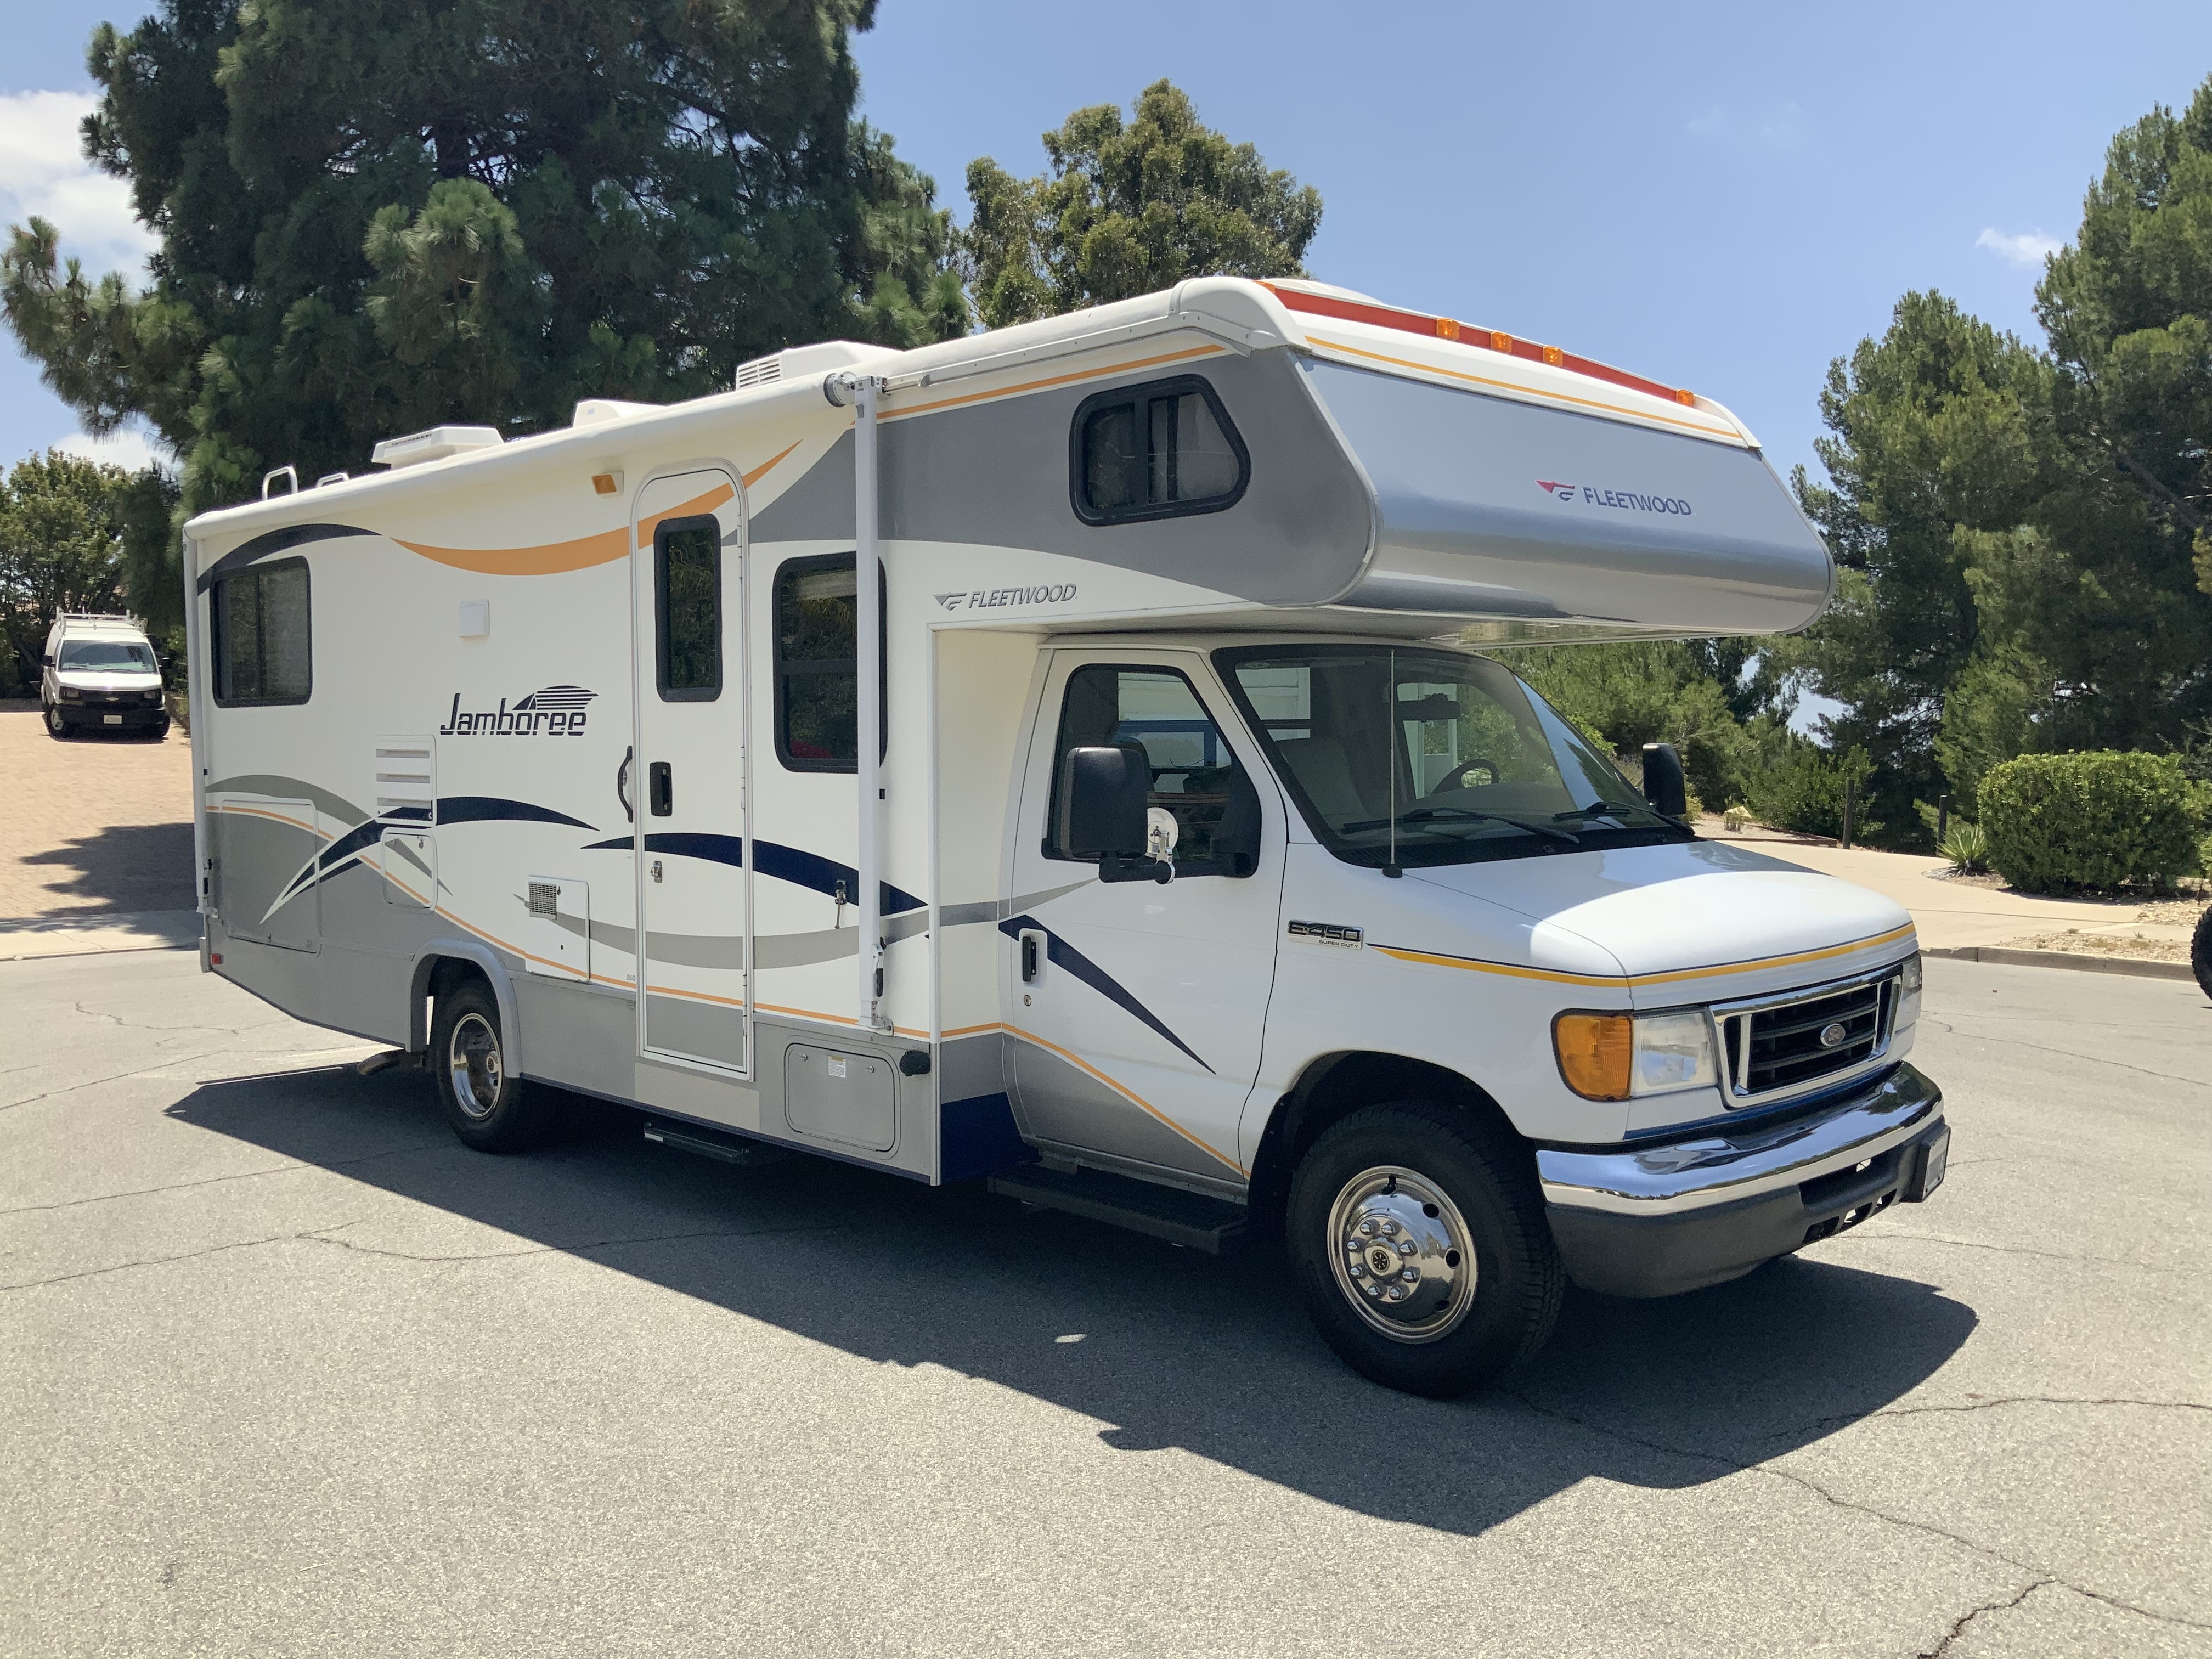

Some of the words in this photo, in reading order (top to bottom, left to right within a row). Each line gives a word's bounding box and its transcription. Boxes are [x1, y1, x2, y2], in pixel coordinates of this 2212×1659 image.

[1582, 487, 1691, 515] FLEETWOOD
[969, 583, 1076, 608] FLEETWOOD
[440, 692, 586, 736] Jamboree
